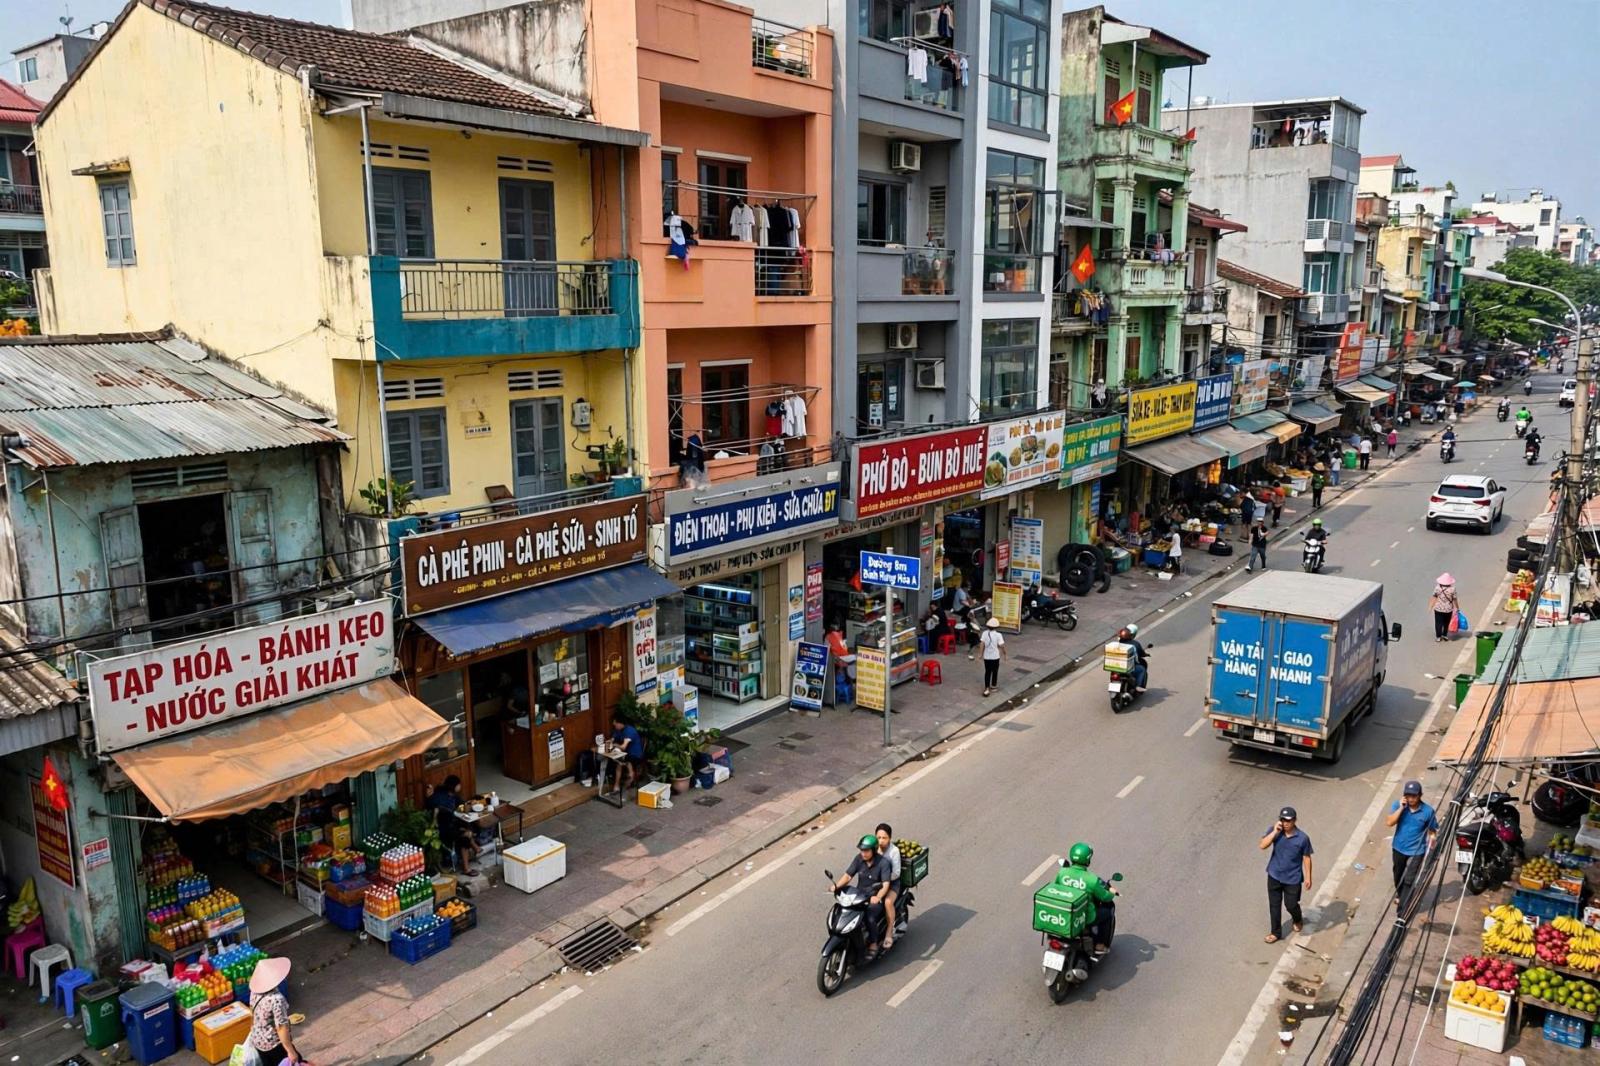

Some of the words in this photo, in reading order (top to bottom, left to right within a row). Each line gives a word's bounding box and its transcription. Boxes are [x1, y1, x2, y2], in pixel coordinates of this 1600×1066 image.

[861, 449, 889, 498] PHỞ
[892, 448, 908, 490] BÒ
[918, 443, 942, 485] BÚN
[945, 438, 960, 478] BÒ
[962, 430, 986, 476] HUẾ
[418, 546, 438, 586] CÀ
[442, 539, 470, 580] PHÊ
[473, 540, 504, 576] PHIN
[516, 528, 535, 565] CÀ
[536, 522, 559, 560] PHÊ
[562, 518, 586, 555] SỮA
[595, 516, 621, 547] SINH
[623, 504, 638, 540] TỐ
[675, 514, 698, 549] ĐIỆN
[701, 512, 728, 542] THOẠI
[736, 508, 755, 534] PHỤ
[756, 498, 776, 530] KIỆN
[784, 490, 800, 520] SỬA
[802, 488, 824, 517] CHỮA
[824, 490, 836, 512] ĐT
[104, 662, 163, 704] TẠP
[174, 645, 232, 686] HÓA
[259, 626, 331, 665] BÁNH
[338, 610, 385, 646] KẸO
[1222, 639, 1244, 658] VẬN
[1246, 641, 1264, 660] TẢI
[1284, 651, 1312, 666] GIAO
[1225, 657, 1256, 676] HÀNG
[1270, 666, 1312, 685] NHANH
[146, 685, 226, 732] NƯỚC
[236, 666, 288, 708] GIẢI
[297, 652, 359, 691] KHÁT
[1062, 875, 1086, 890] Grab
[1038, 910, 1066, 926] Grab
